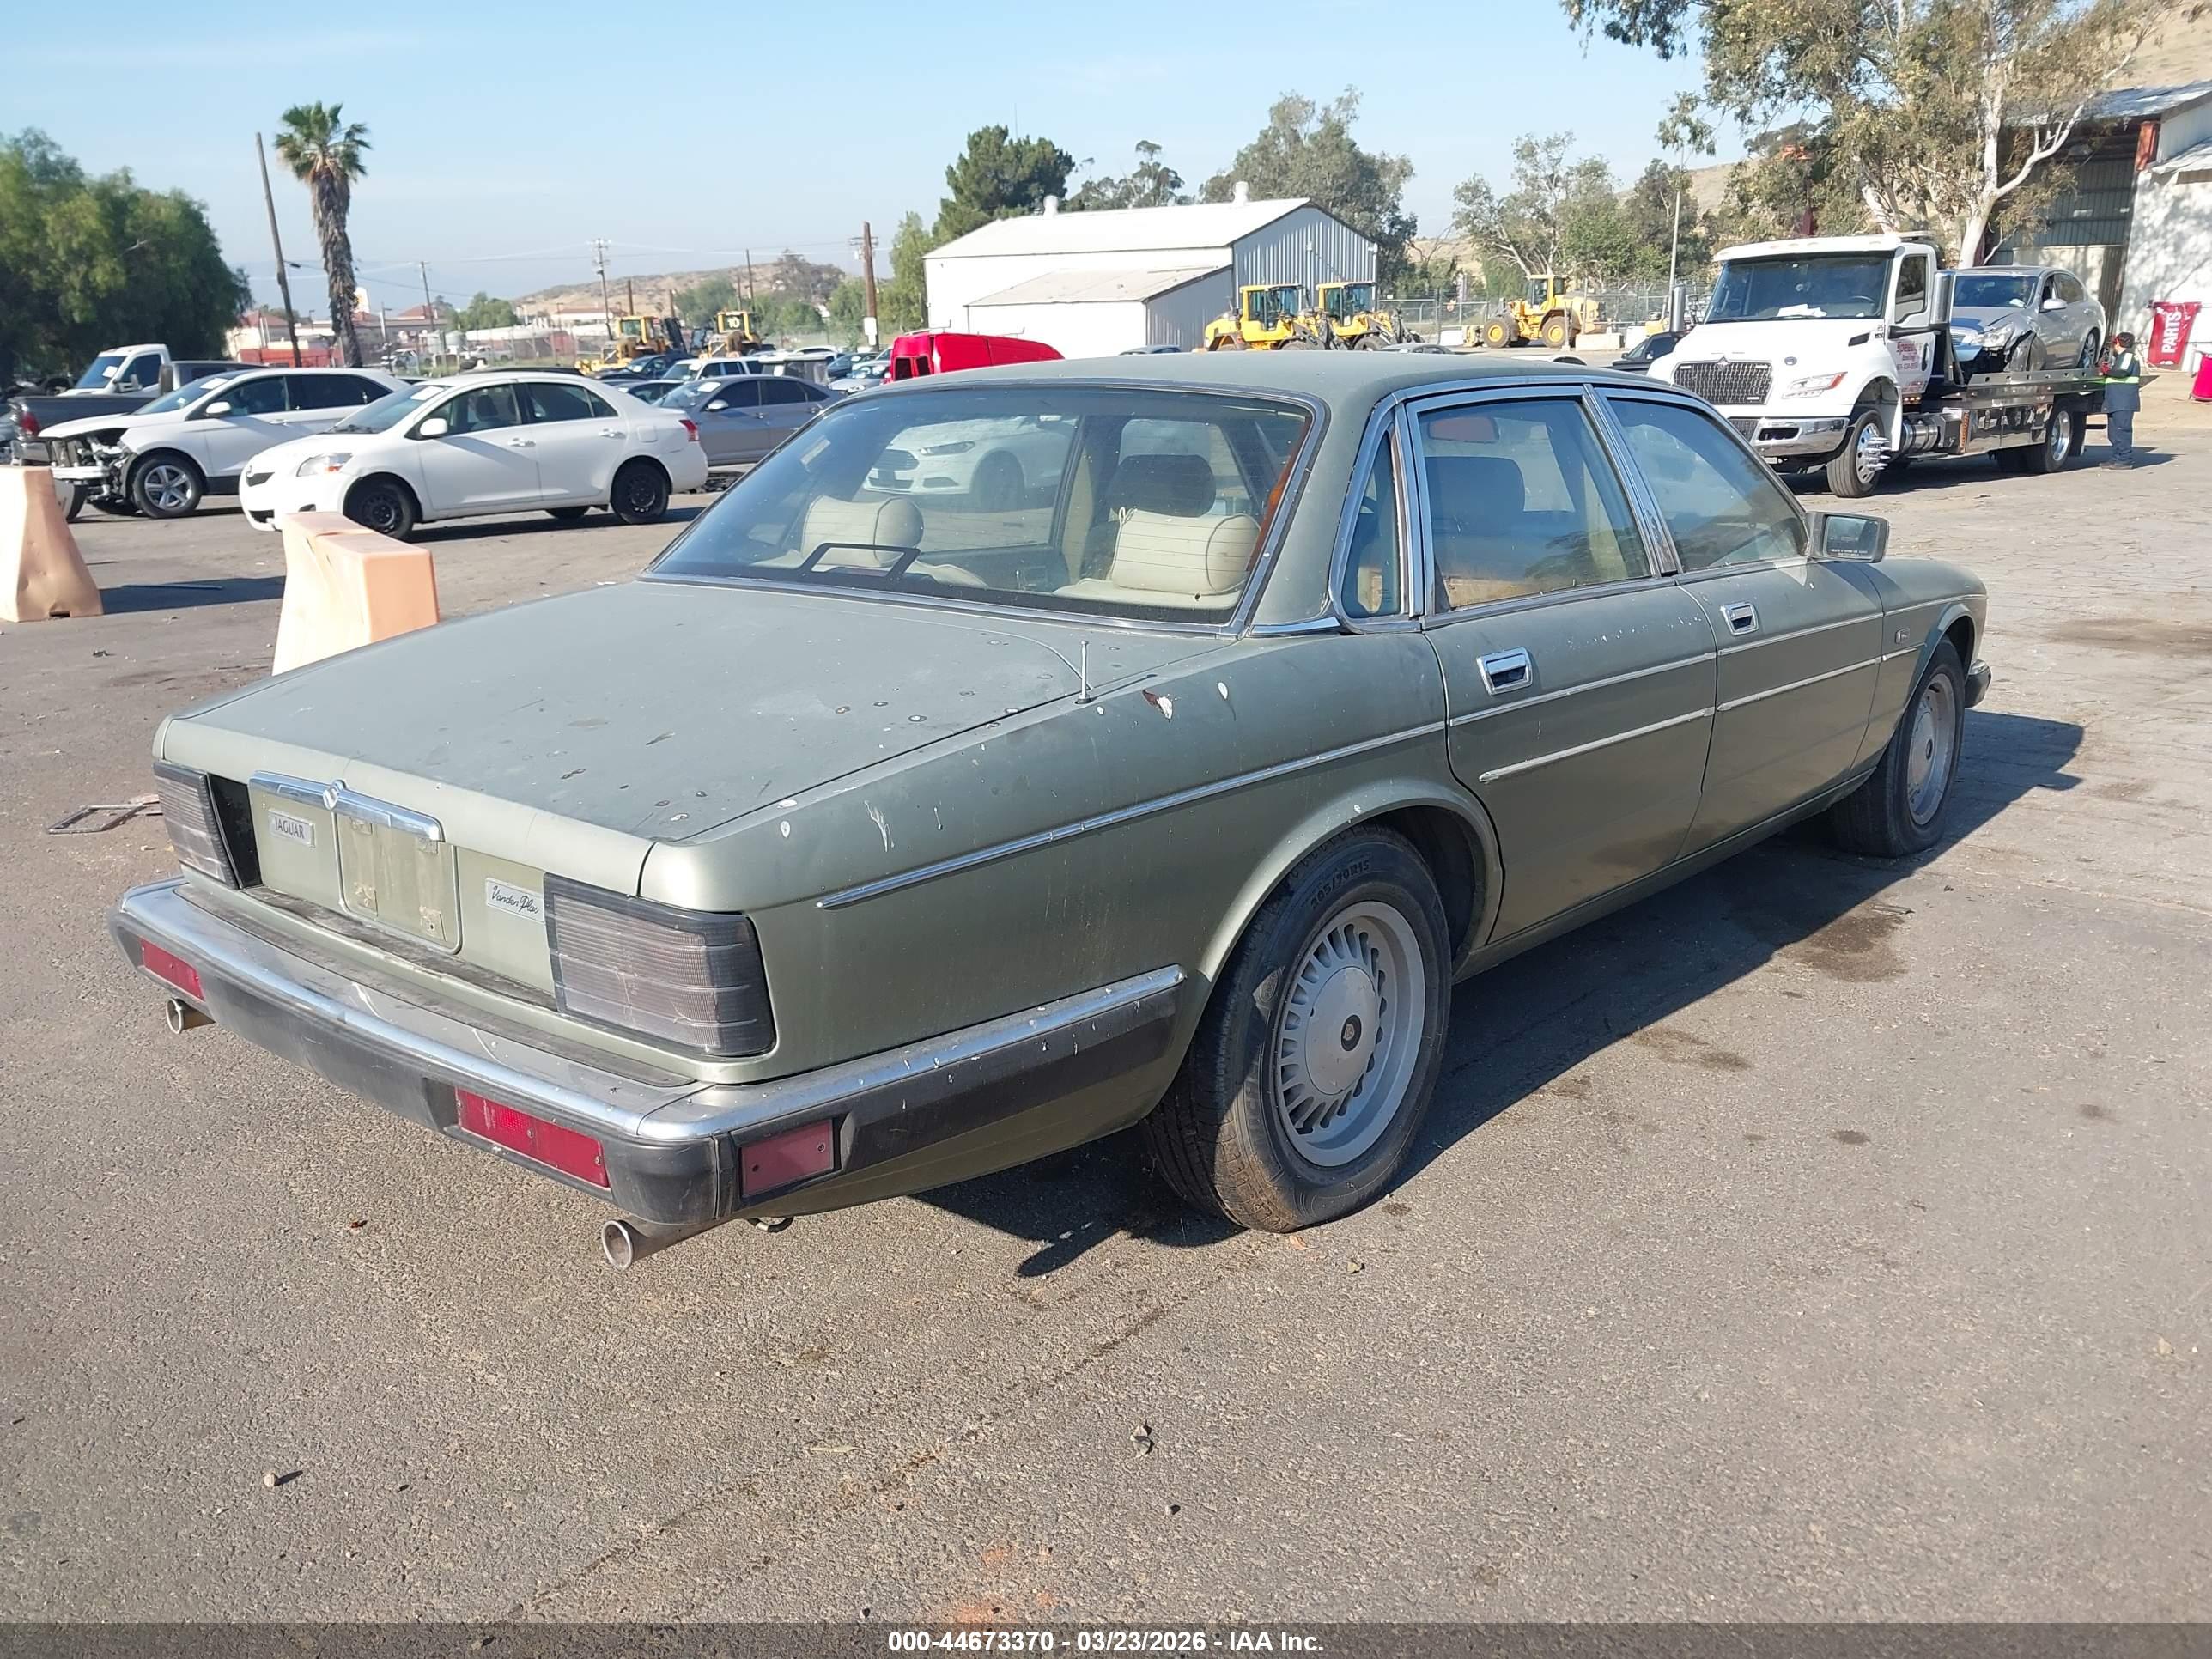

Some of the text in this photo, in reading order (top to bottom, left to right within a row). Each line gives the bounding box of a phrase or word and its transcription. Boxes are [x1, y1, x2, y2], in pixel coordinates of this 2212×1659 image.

[2161, 311, 2182, 354] PARTS
[275, 817, 306, 839] JAGUAR
[491, 885, 520, 907] Vanden
